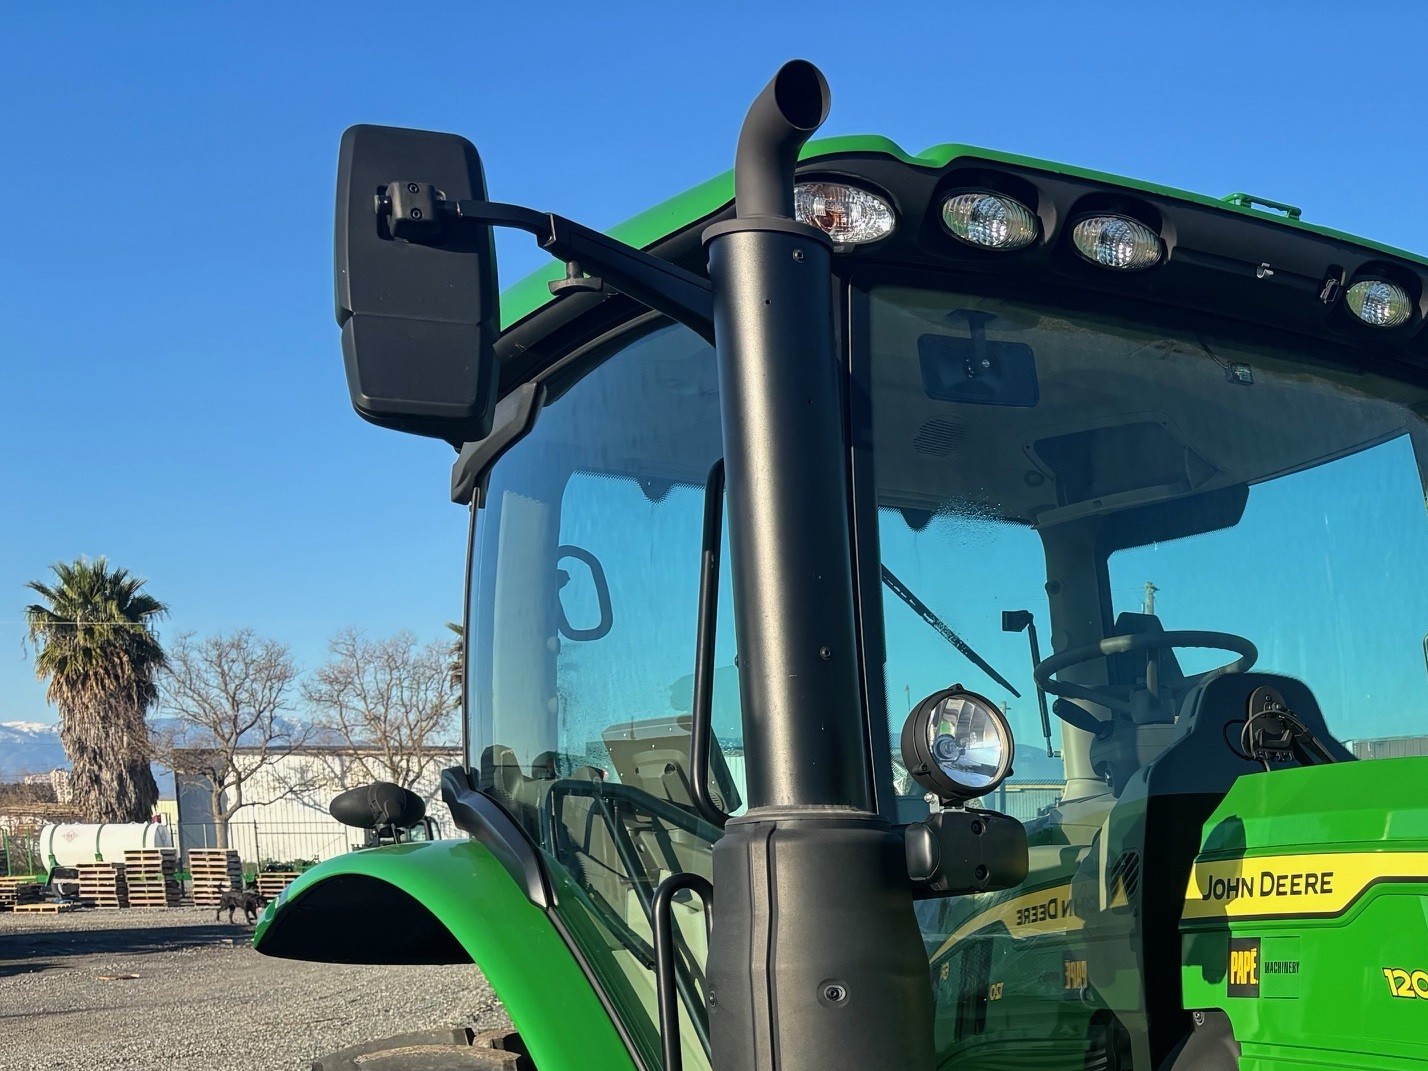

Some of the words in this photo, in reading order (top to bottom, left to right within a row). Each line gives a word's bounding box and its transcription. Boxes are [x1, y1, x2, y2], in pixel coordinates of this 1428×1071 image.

[1202, 874, 1255, 901] JOHN
[1259, 871, 1334, 897] DEERE
[1264, 961, 1300, 974] MACHINERY
